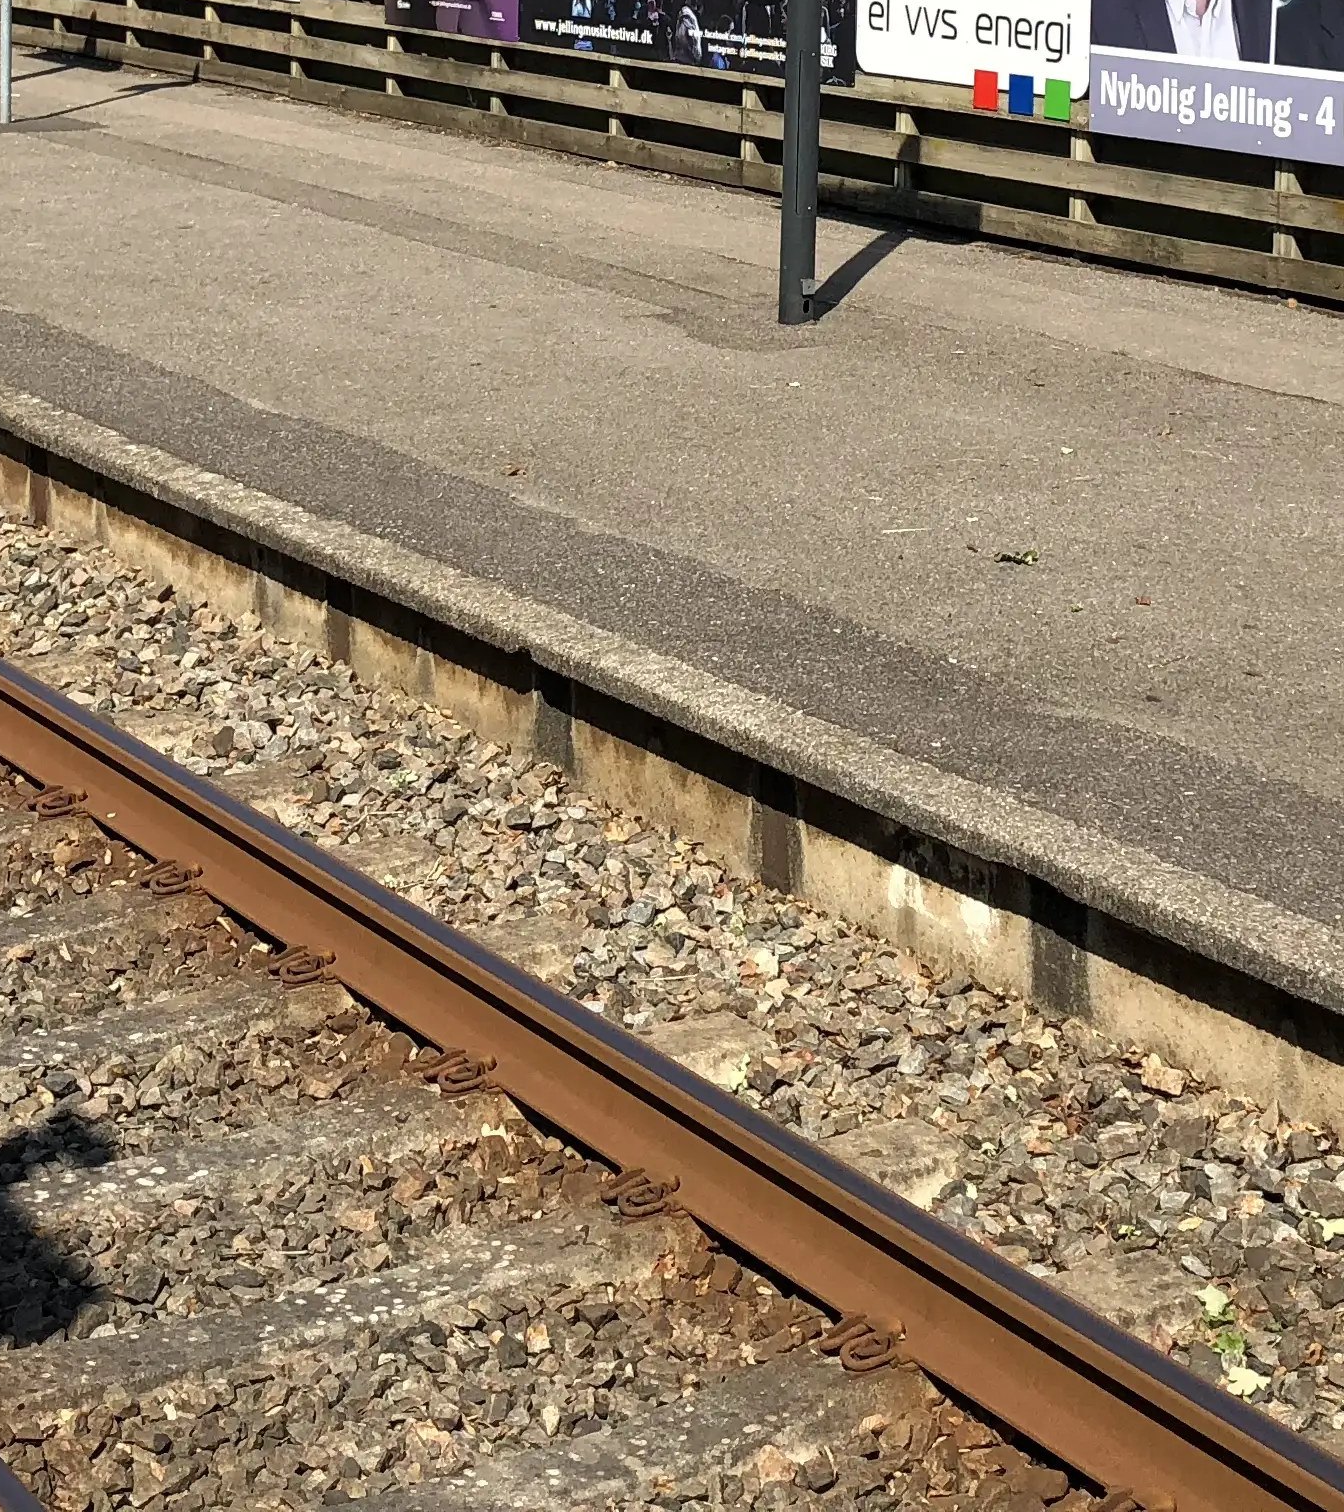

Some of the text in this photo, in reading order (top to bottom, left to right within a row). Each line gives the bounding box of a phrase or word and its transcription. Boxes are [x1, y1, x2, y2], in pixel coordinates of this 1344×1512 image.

[534, 18, 653, 45] www.jellingmusikfestival.dk
[905, 4, 958, 40] vvs
[975, 12, 1072, 63] energi
[1100, 71, 1196, 123] Nybolig
[1199, 82, 1293, 134] Jelling
[1315, 96, 1336, 135] 4
